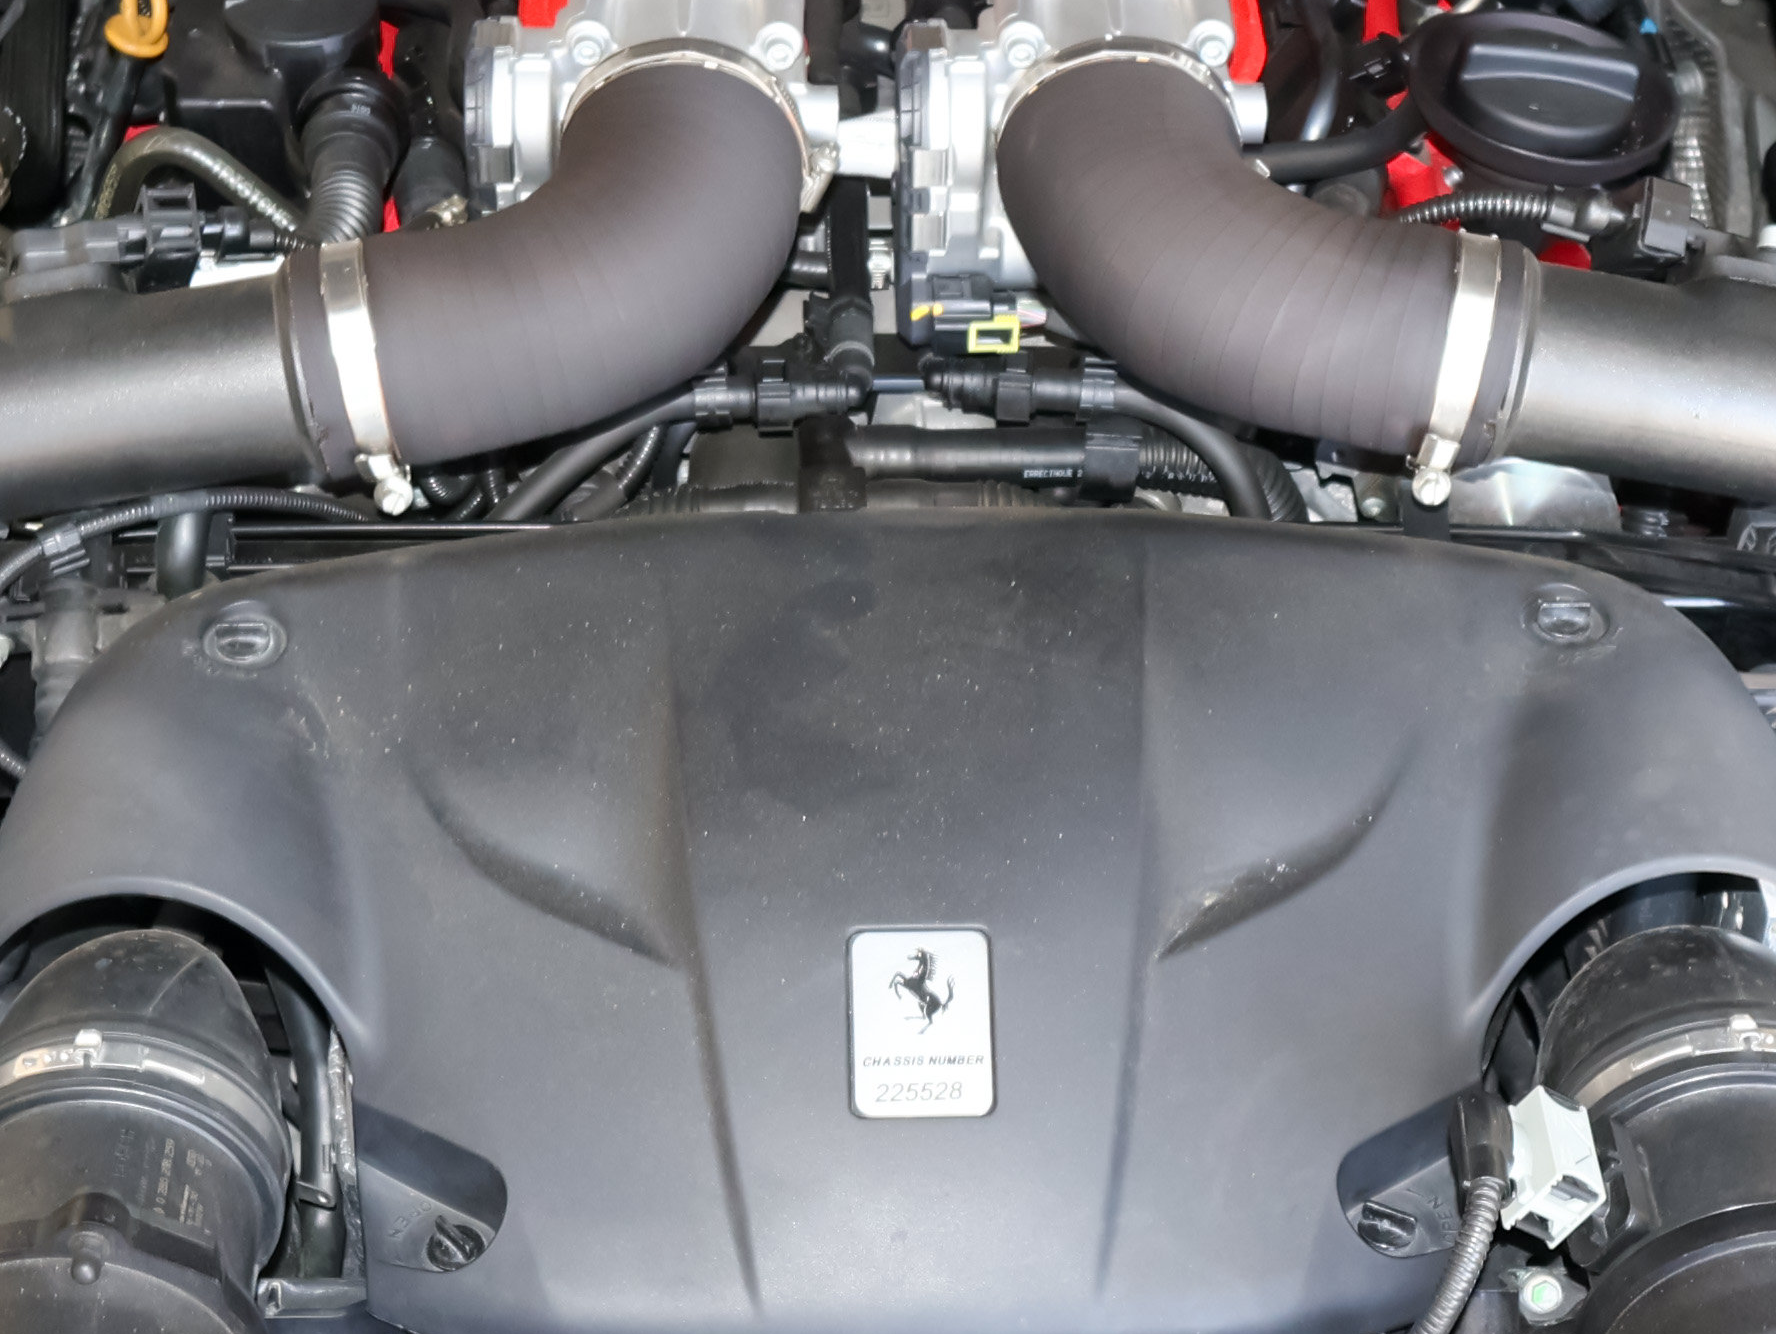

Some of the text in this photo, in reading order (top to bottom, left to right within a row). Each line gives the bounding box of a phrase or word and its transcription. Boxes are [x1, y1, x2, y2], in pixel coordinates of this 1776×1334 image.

[863, 1055, 985, 1067] CHASSIS NUMBER
[875, 1081, 963, 1103] 225528
